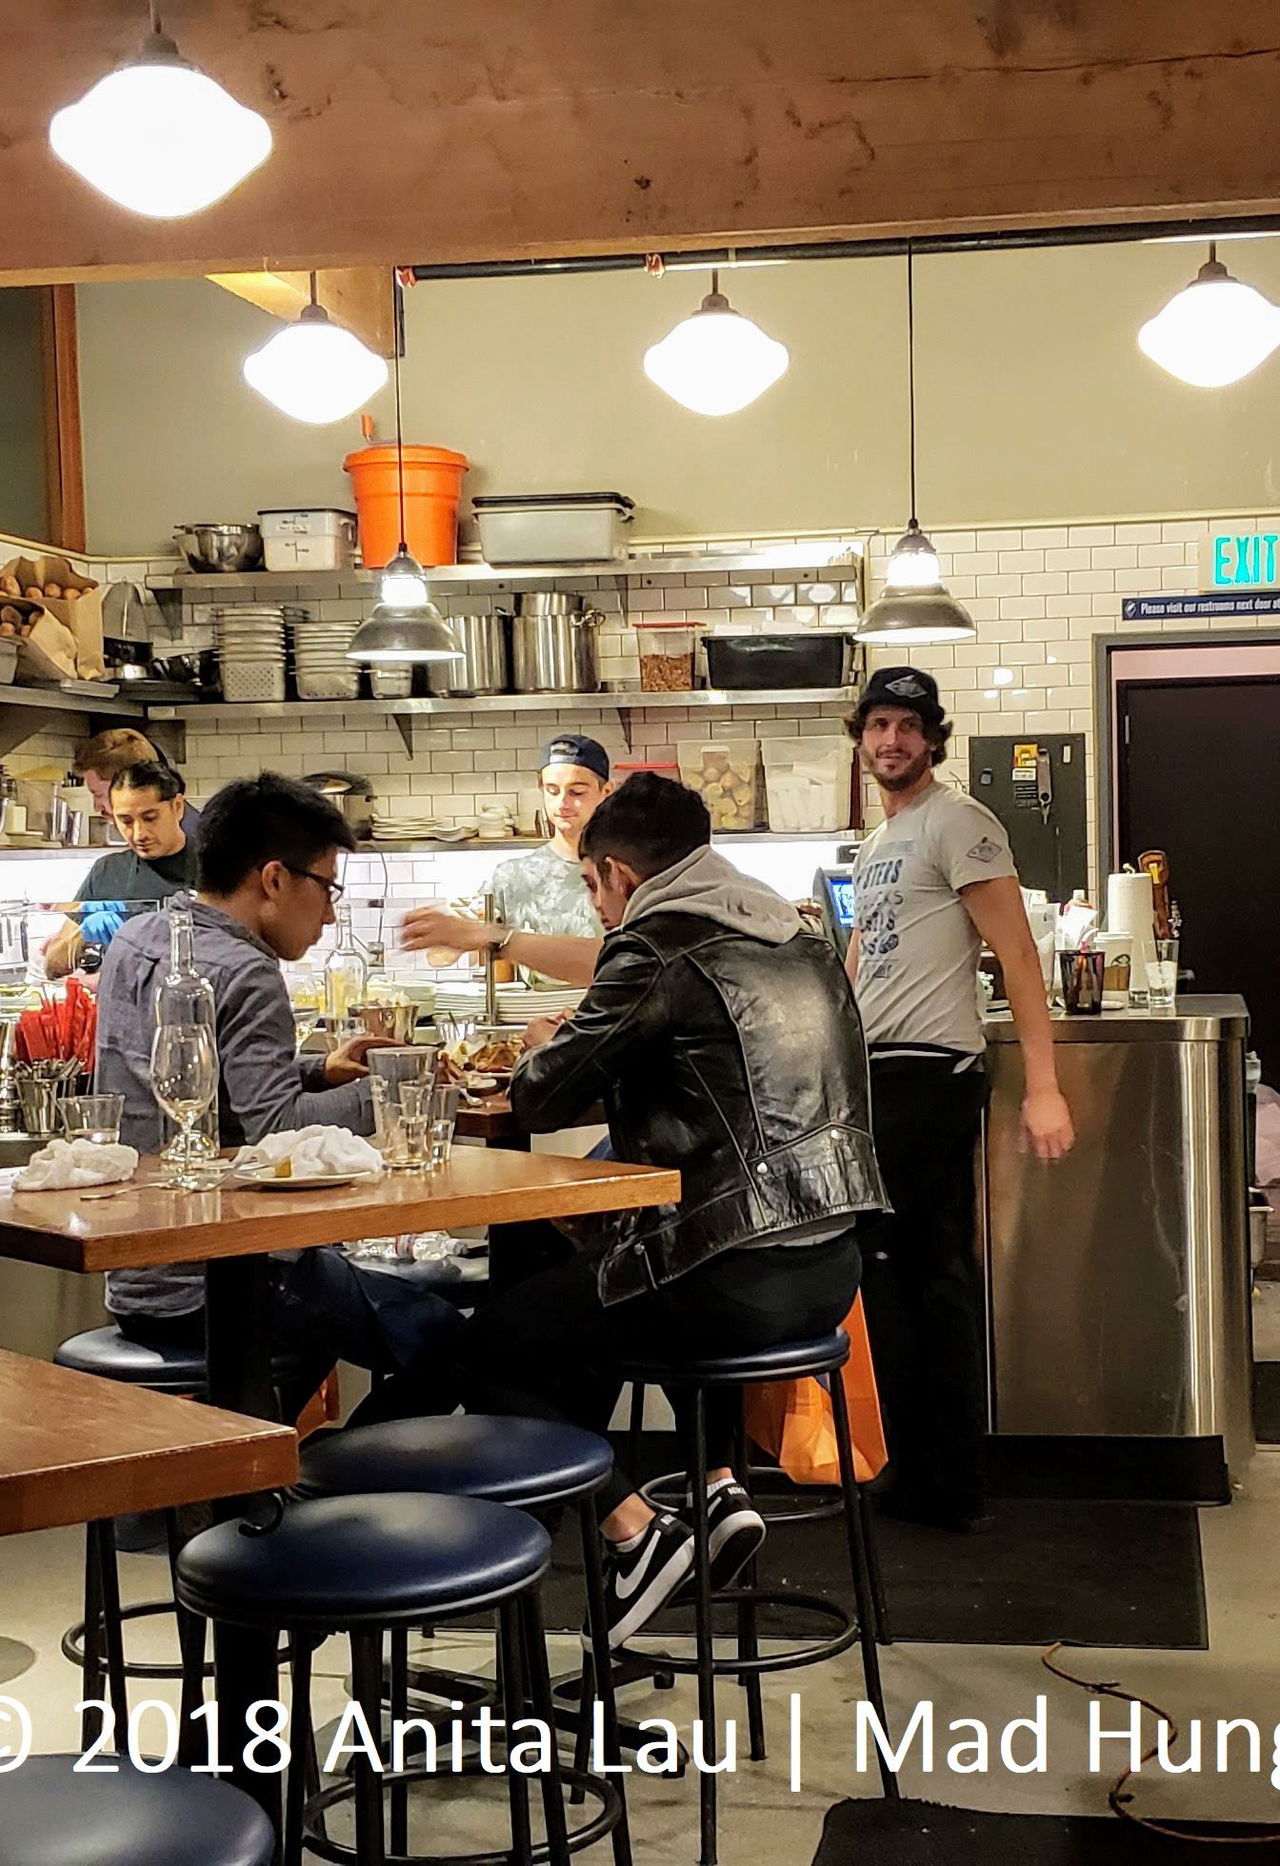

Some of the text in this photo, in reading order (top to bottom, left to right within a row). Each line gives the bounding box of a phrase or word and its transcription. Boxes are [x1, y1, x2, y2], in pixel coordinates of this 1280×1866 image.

[1214, 535, 1279, 585] EXIT
[1140, 602, 1165, 615] Please
[1166, 602, 1183, 613] visit
[1184, 602, 1197, 613] our
[1198, 600, 1235, 612] restrooms
[1236, 599, 1253, 610] next
[1254, 598, 1272, 609] door
[1272, 598, 1280, 609] at
